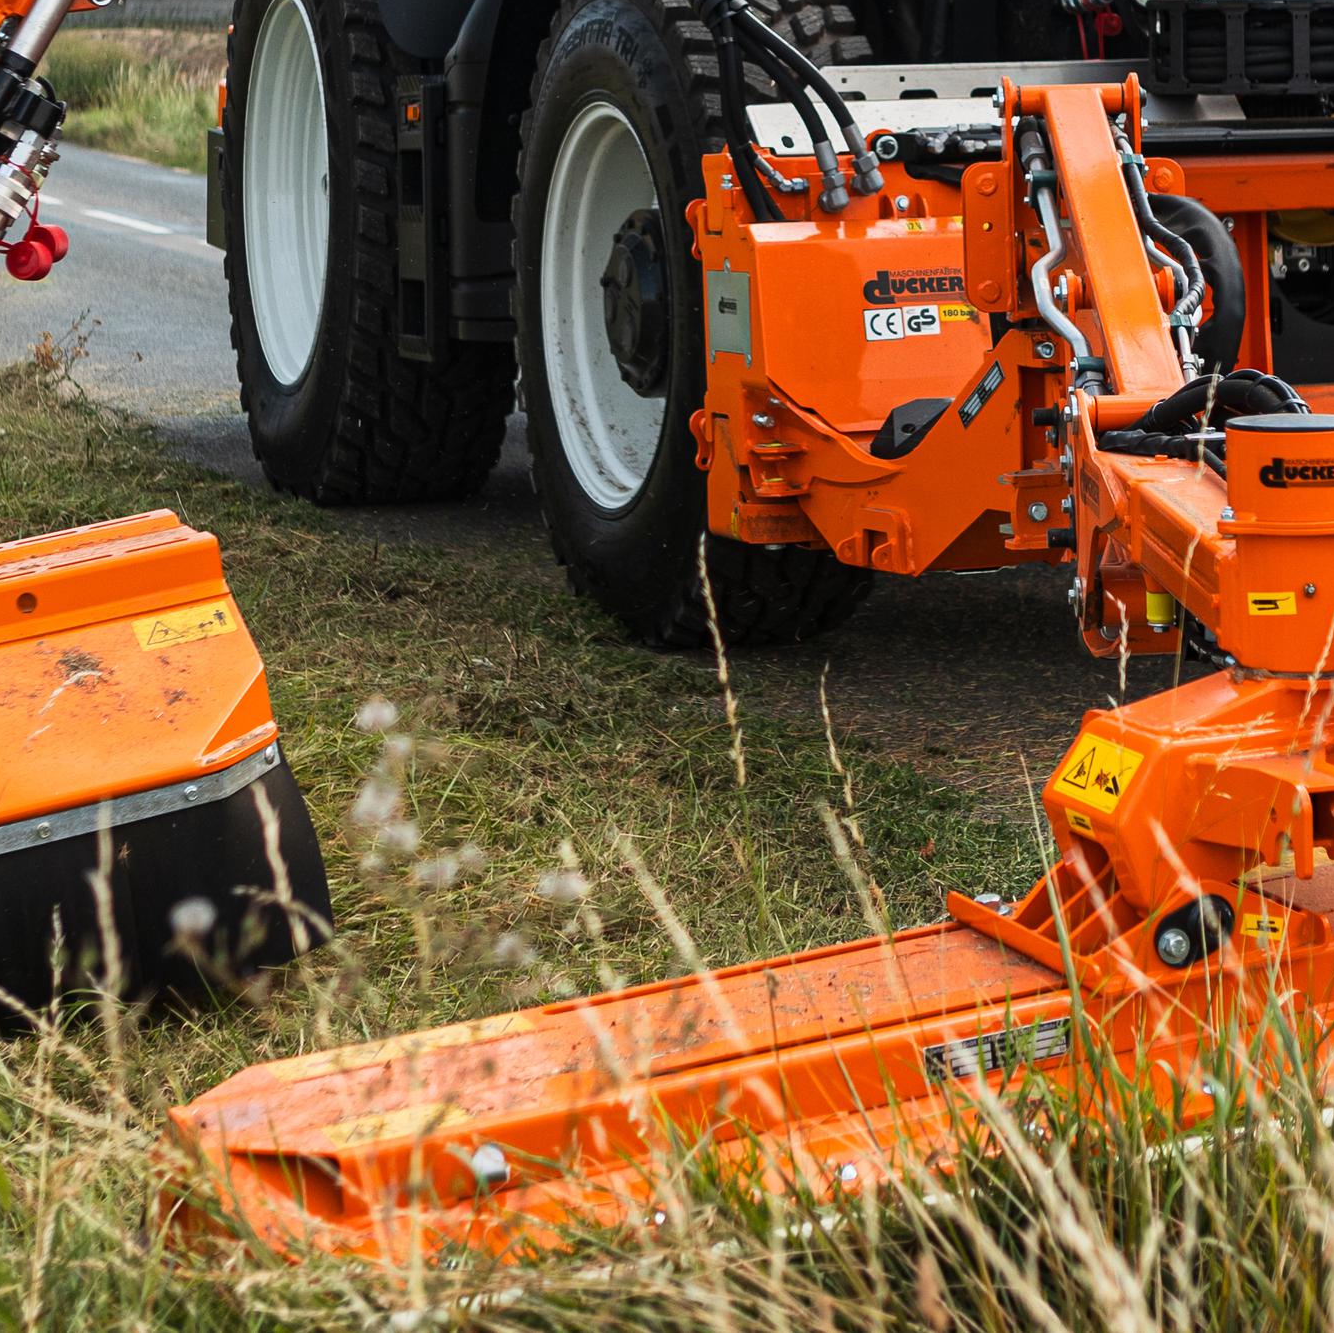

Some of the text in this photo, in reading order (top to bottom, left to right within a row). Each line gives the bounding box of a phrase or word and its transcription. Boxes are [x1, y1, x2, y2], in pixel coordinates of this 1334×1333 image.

[870, 312, 898, 336] CE
[907, 308, 936, 333] GS
[942, 309, 959, 318] 180
